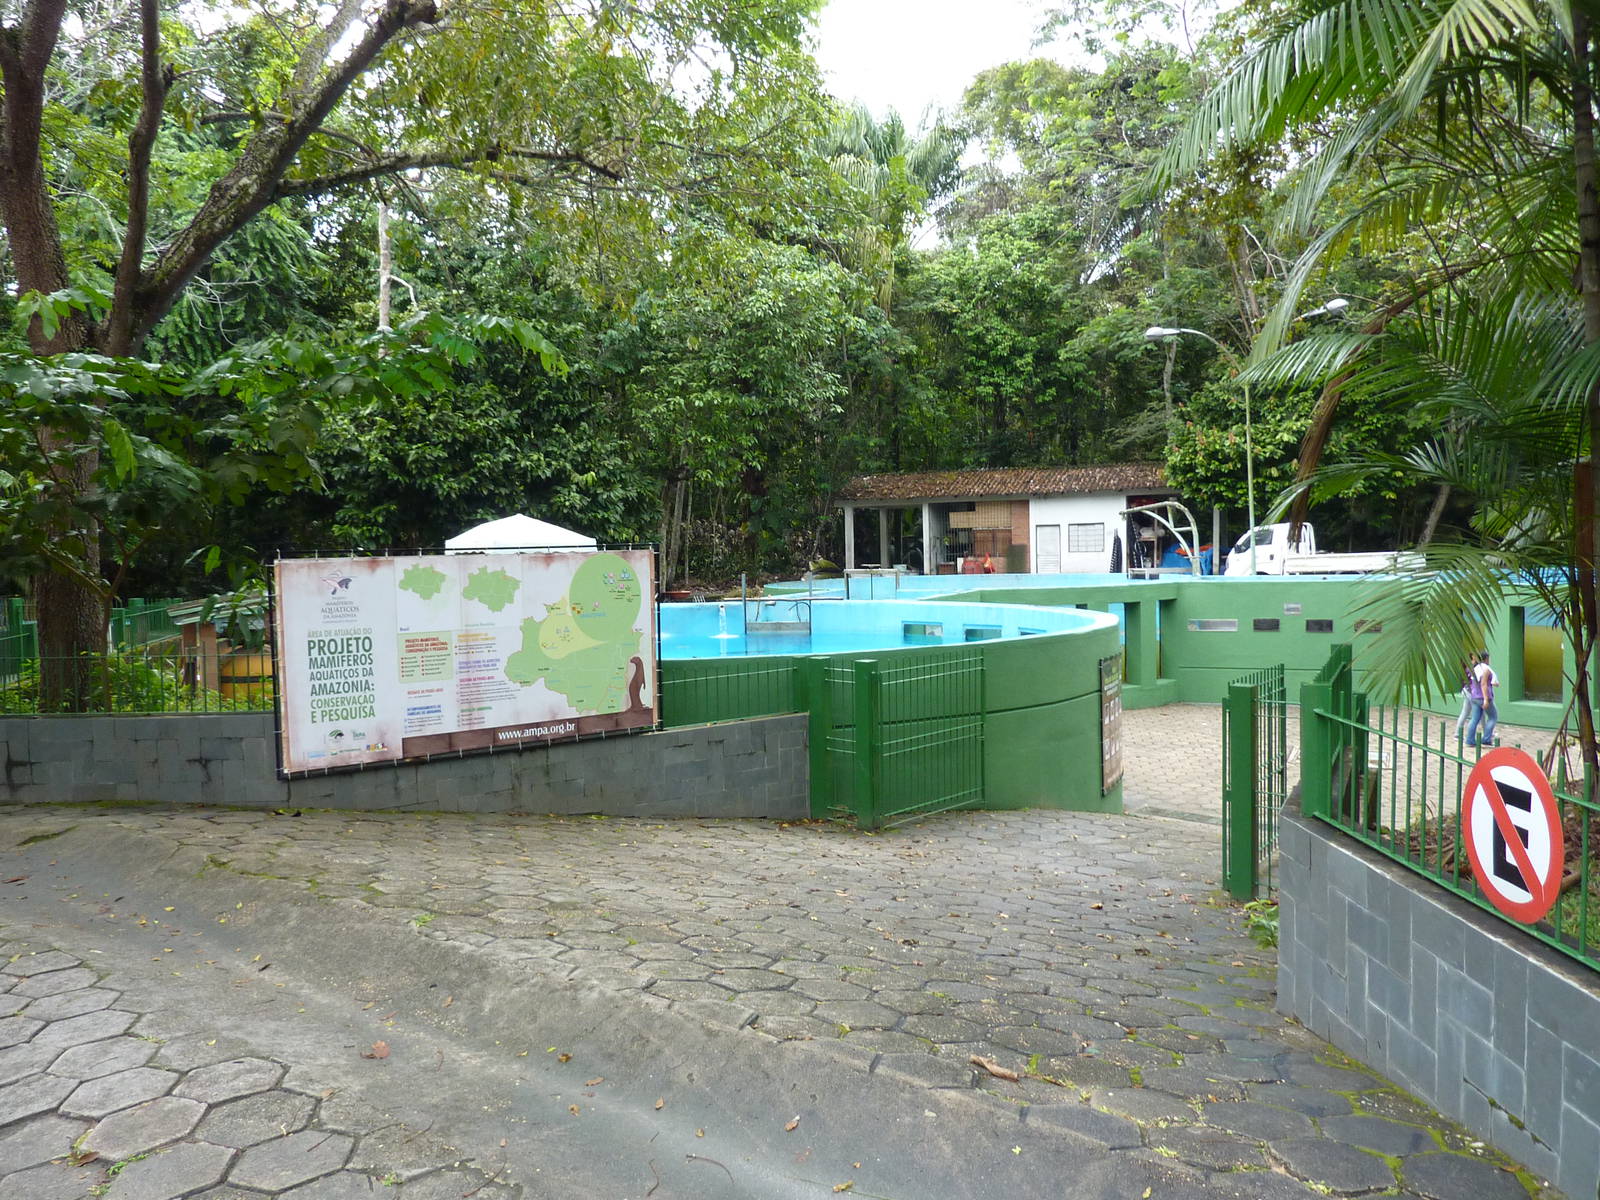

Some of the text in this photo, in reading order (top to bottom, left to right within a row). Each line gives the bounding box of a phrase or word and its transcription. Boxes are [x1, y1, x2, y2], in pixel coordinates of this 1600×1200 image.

[324, 630, 332, 638] DE
[363, 627, 373, 635] DO
[307, 636, 373, 656] PROJETO
[362, 667, 374, 677] DA
[311, 705, 376, 724] E PESQUISA
[498, 722, 575, 740] www.ampa.org.br
[1493, 780, 1532, 893] E
